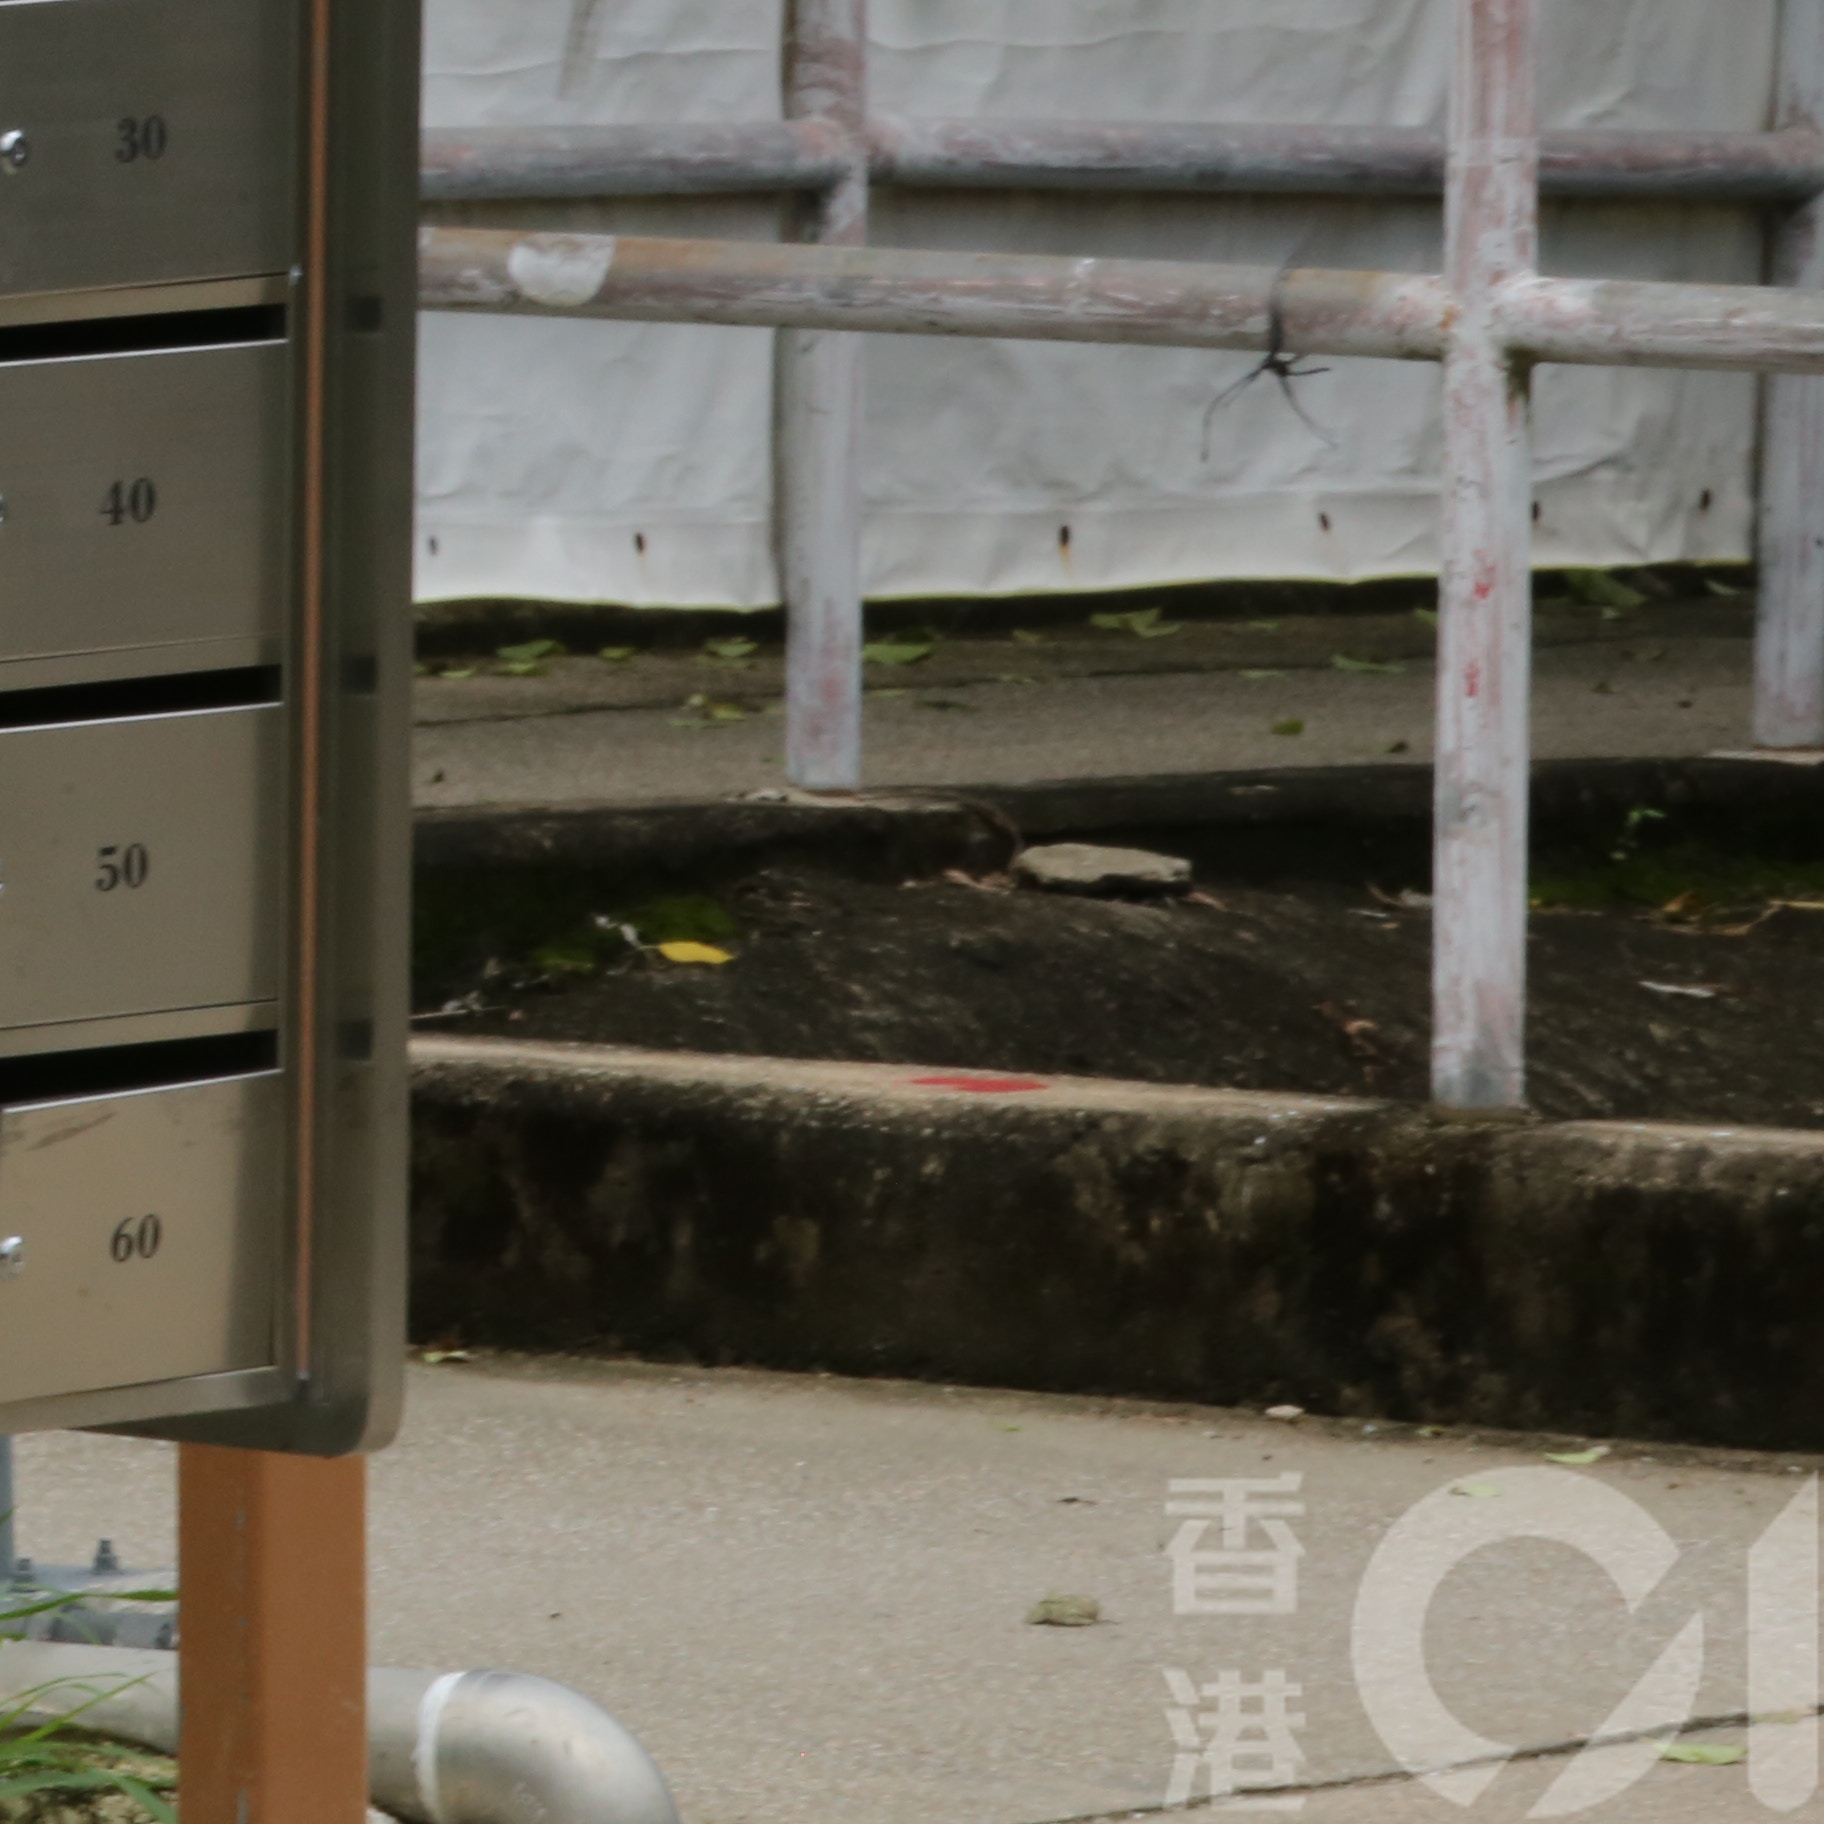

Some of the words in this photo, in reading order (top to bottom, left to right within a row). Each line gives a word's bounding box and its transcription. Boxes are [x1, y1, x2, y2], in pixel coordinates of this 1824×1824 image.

[115, 115, 168, 163] 30
[100, 478, 157, 526] 40
[95, 843, 149, 892] 50
[110, 1214, 162, 1263] 60
